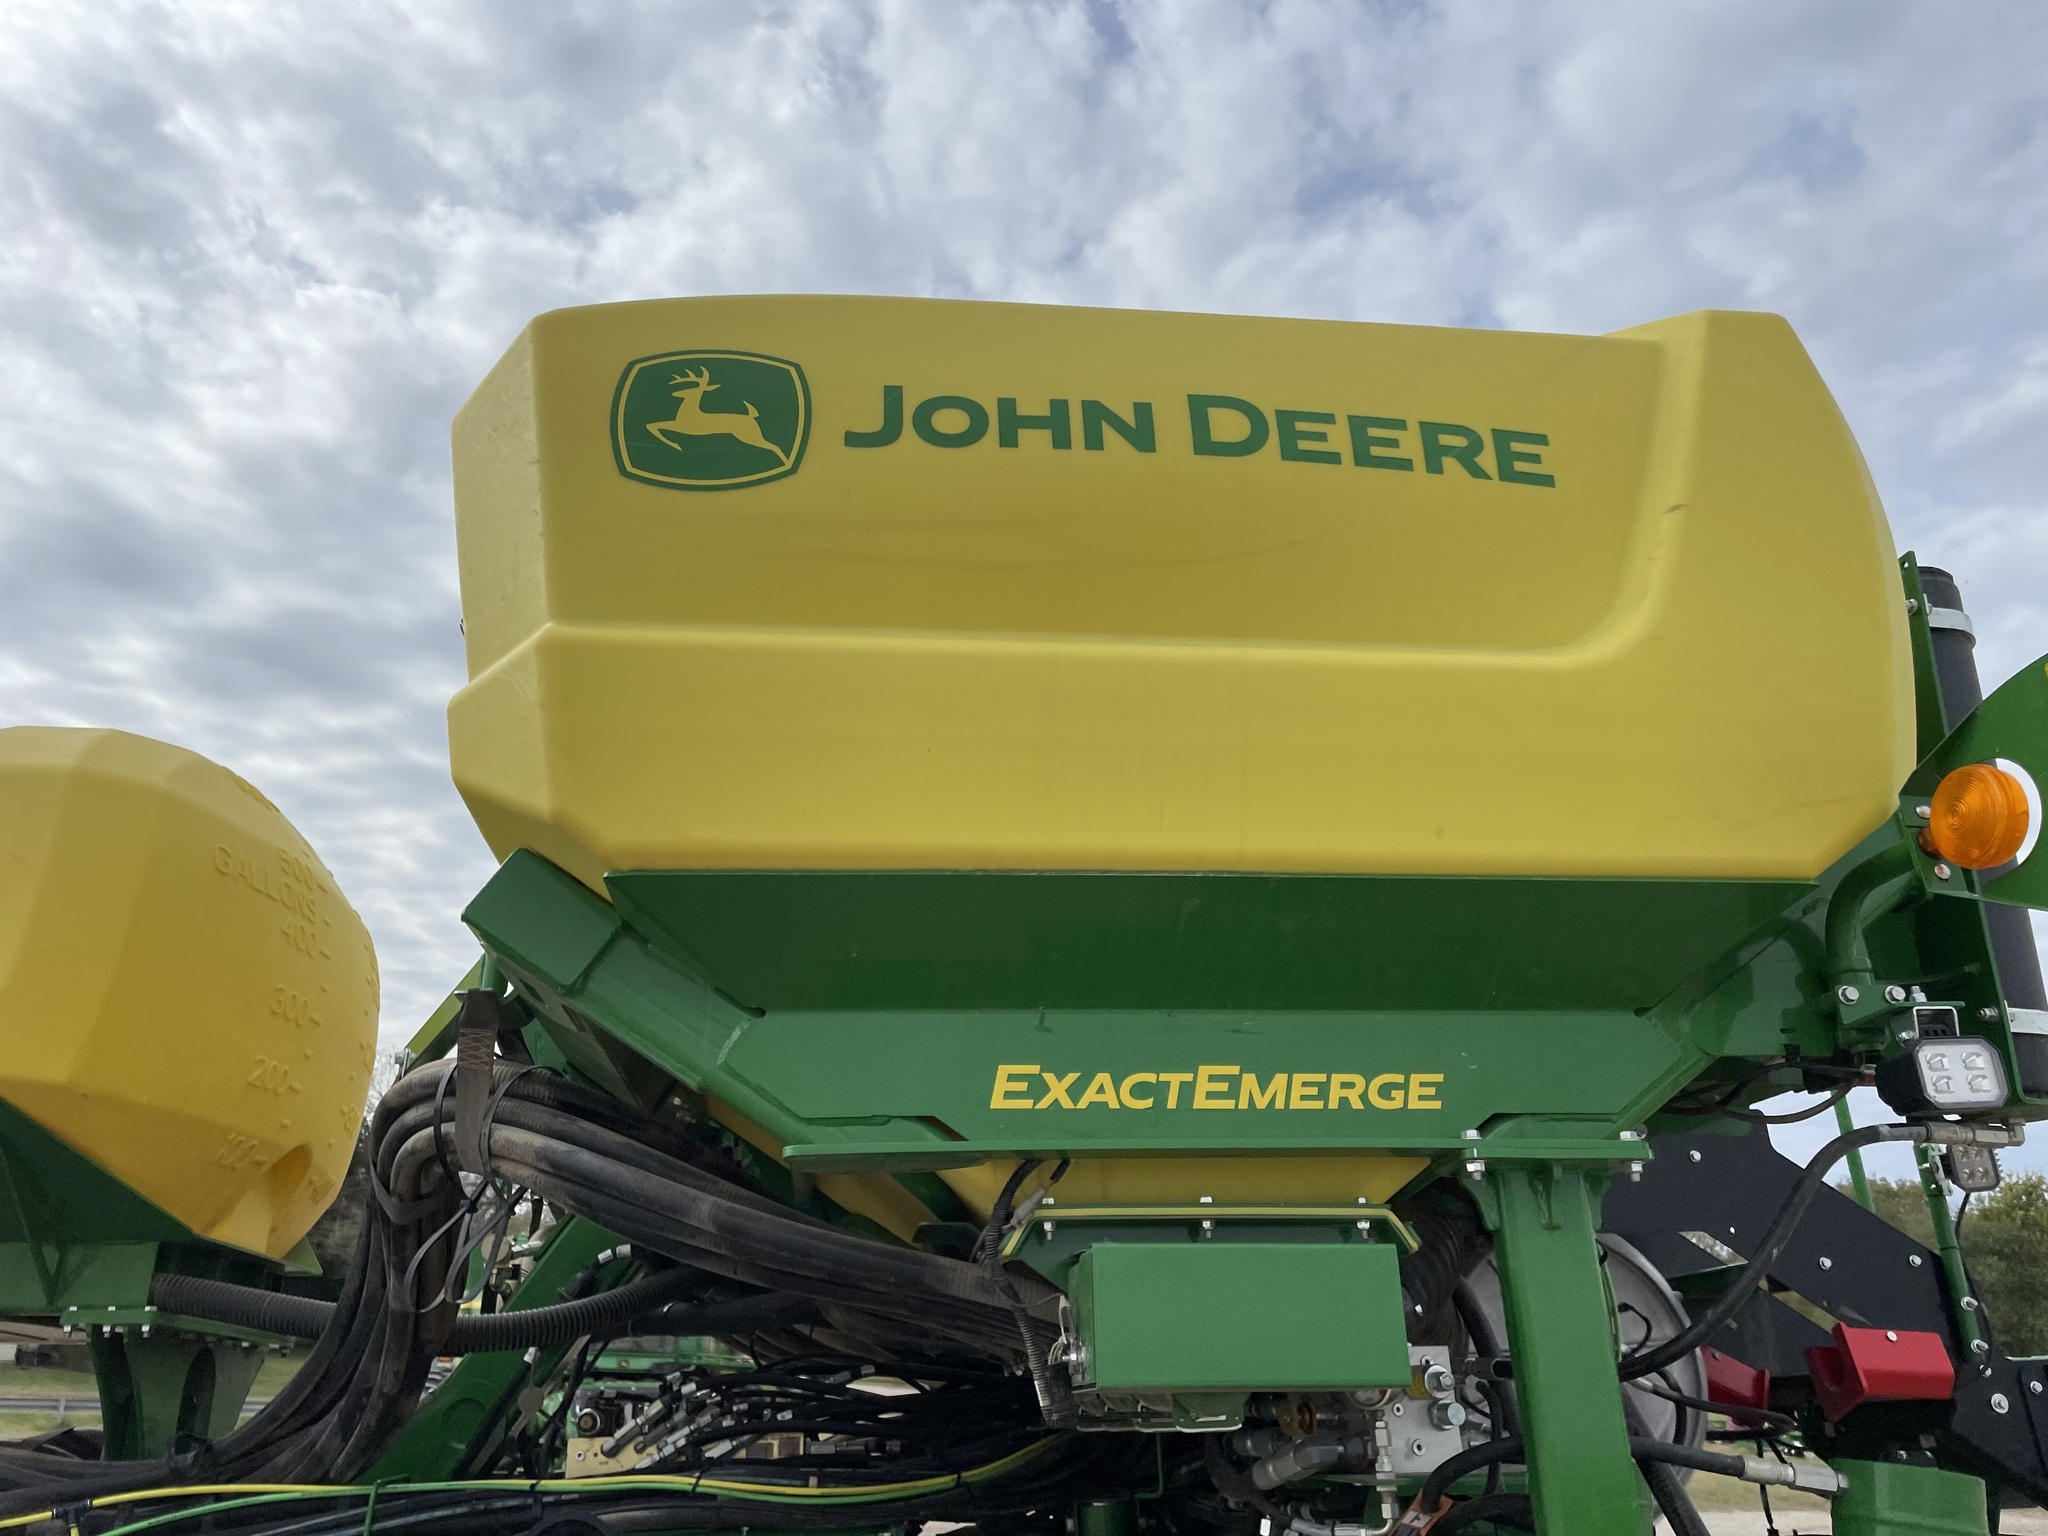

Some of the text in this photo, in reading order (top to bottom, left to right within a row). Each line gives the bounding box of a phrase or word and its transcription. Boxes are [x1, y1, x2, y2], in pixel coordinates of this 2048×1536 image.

[844, 385, 1556, 488] JOHN DEERE
[214, 844, 317, 925] GALLONS
[279, 917, 316, 960] 400
[270, 983, 309, 1028] 300
[246, 1055, 289, 1097] 200
[990, 1064, 1444, 1110] EXACTEMERGE
